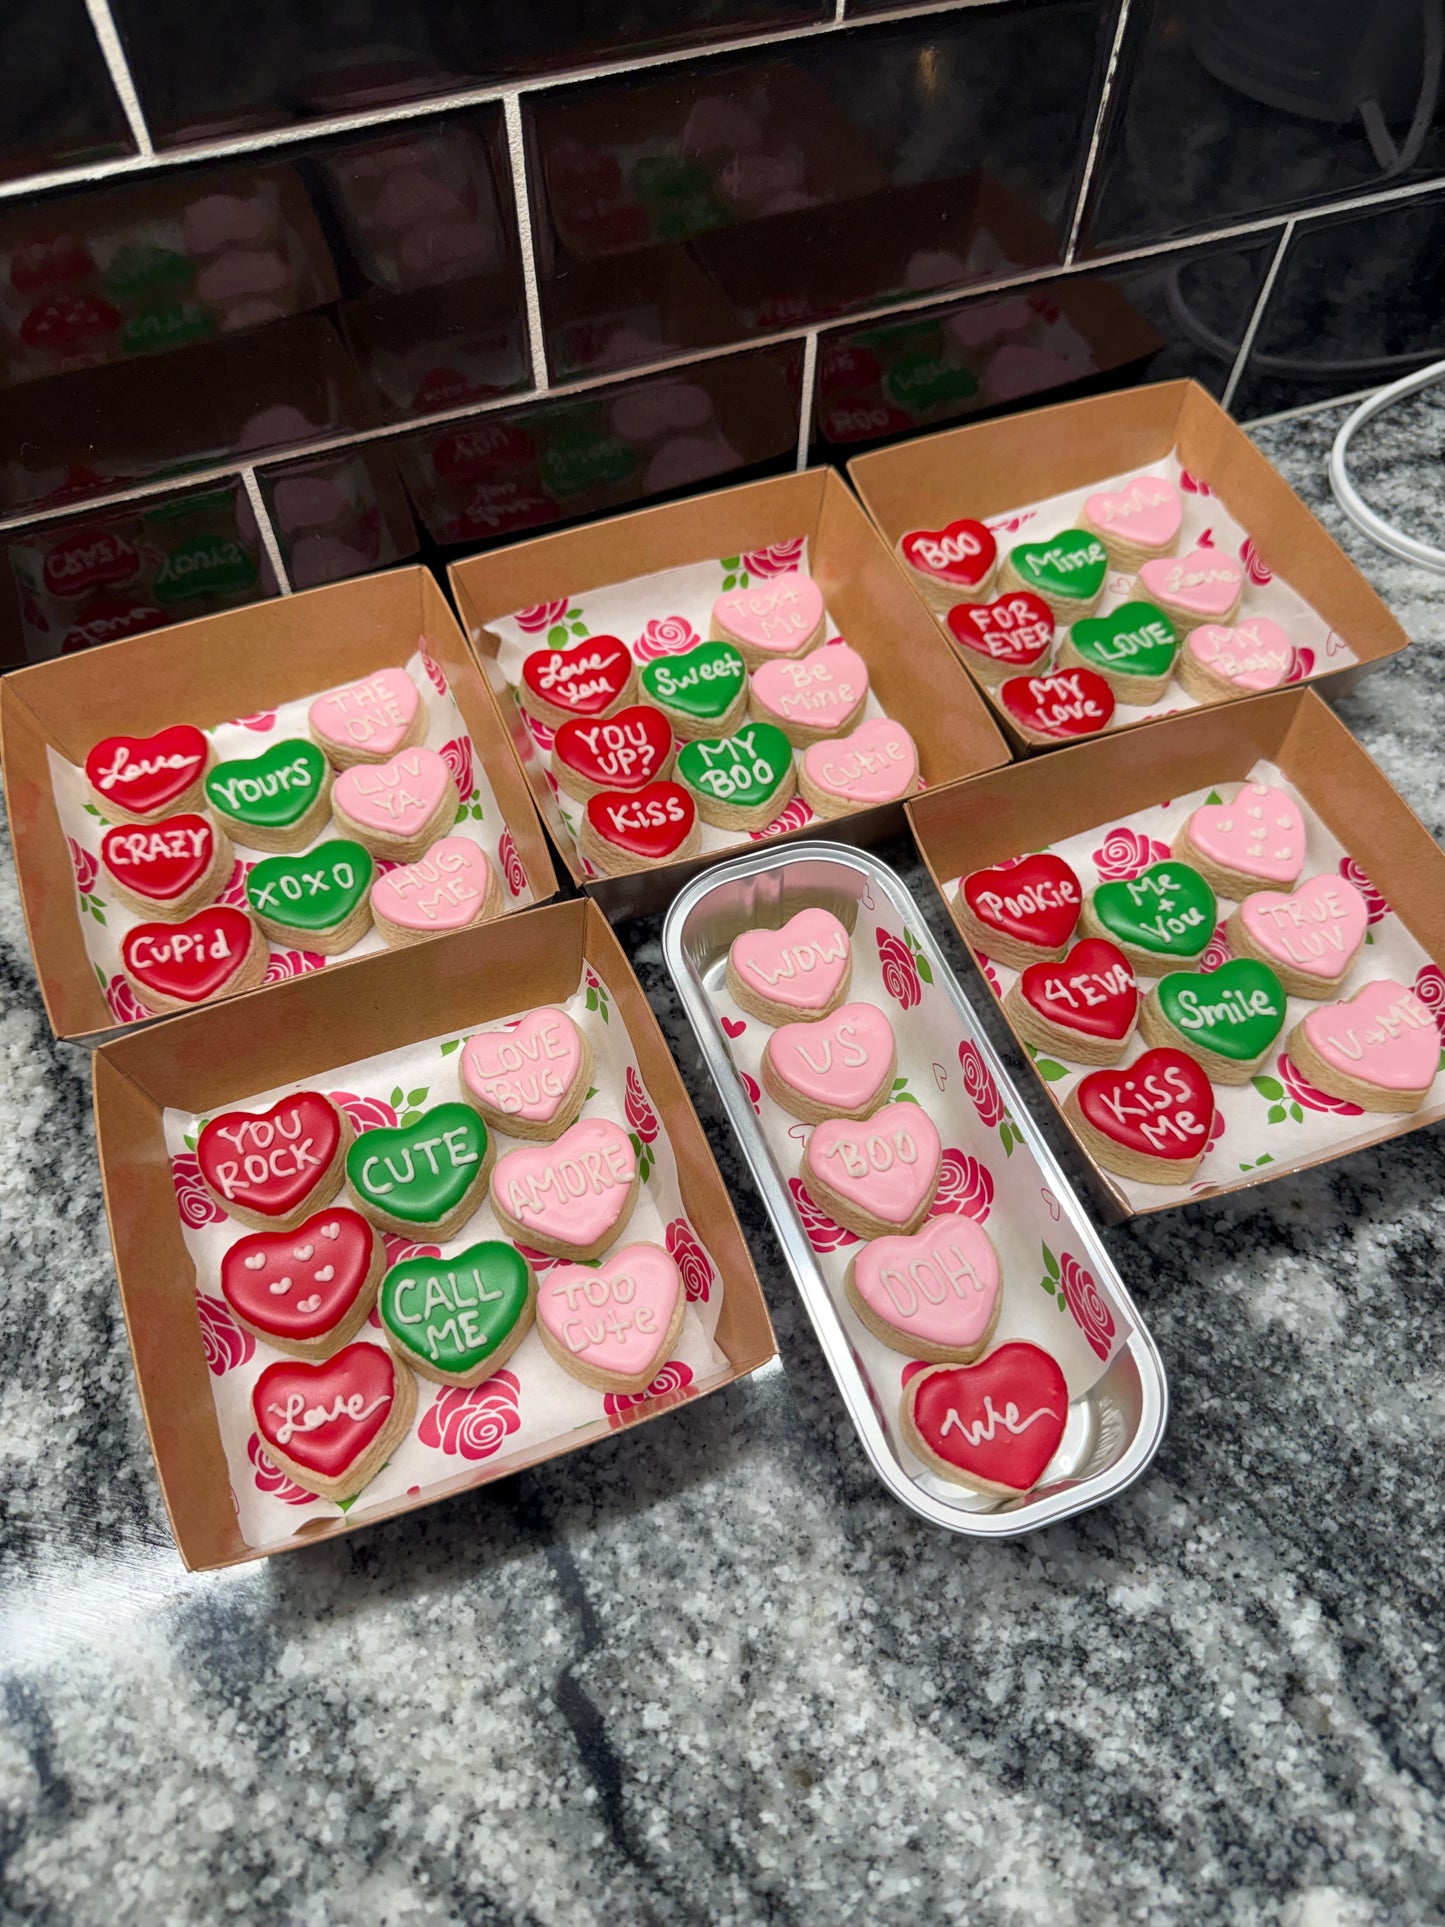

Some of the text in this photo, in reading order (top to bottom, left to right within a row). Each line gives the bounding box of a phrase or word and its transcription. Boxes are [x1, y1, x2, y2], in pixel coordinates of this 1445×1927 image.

[913, 530, 981, 569] BOO
[1025, 541, 1106, 576] Mine
[761, 611, 808, 639] Me
[970, 600, 1039, 632] FOR
[984, 622, 1052, 657] EVER
[1094, 623, 1175, 661] LOVE
[1207, 625, 1265, 653] MY
[655, 650, 742, 696] Sweet
[781, 659, 834, 690] Be
[1029, 673, 1087, 703] MY
[326, 677, 396, 713] THE
[779, 681, 856, 716] Mine
[345, 702, 408, 743] ONE
[575, 722, 648, 755] YOU
[597, 745, 655, 777] UP?
[697, 731, 757, 767] MY
[821, 738, 907, 788] Cutie
[352, 755, 422, 797] LUV
[700, 760, 774, 798] BOO
[372, 789, 426, 819] YA
[107, 828, 210, 866] CRAZY
[249, 862, 355, 910] XOXO
[386, 849, 473, 899] HUG
[1127, 873, 1182, 906] Me
[416, 877, 481, 920] ME
[1257, 891, 1349, 931] TRUE
[1140, 906, 1206, 944] You
[1279, 925, 1346, 963] LUV
[746, 931, 848, 986] WOW
[1045, 963, 1137, 1008] 4EVA
[1178, 988, 1277, 1030] Smile
[471, 1022, 571, 1079] LOVE
[796, 1023, 869, 1075] US
[483, 1067, 565, 1114] BUG
[217, 1109, 303, 1155] YOU
[1140, 1109, 1205, 1150] Me
[216, 1138, 322, 1199] ROCK
[361, 1126, 479, 1195] CUTE
[825, 1128, 918, 1180] BOO
[507, 1143, 635, 1221] AMORE
[393, 1268, 504, 1325] CALL
[551, 1274, 636, 1311] TOO
[427, 1309, 489, 1360] ME
[268, 1392, 392, 1444] Love
[940, 1395, 1061, 1446] We
